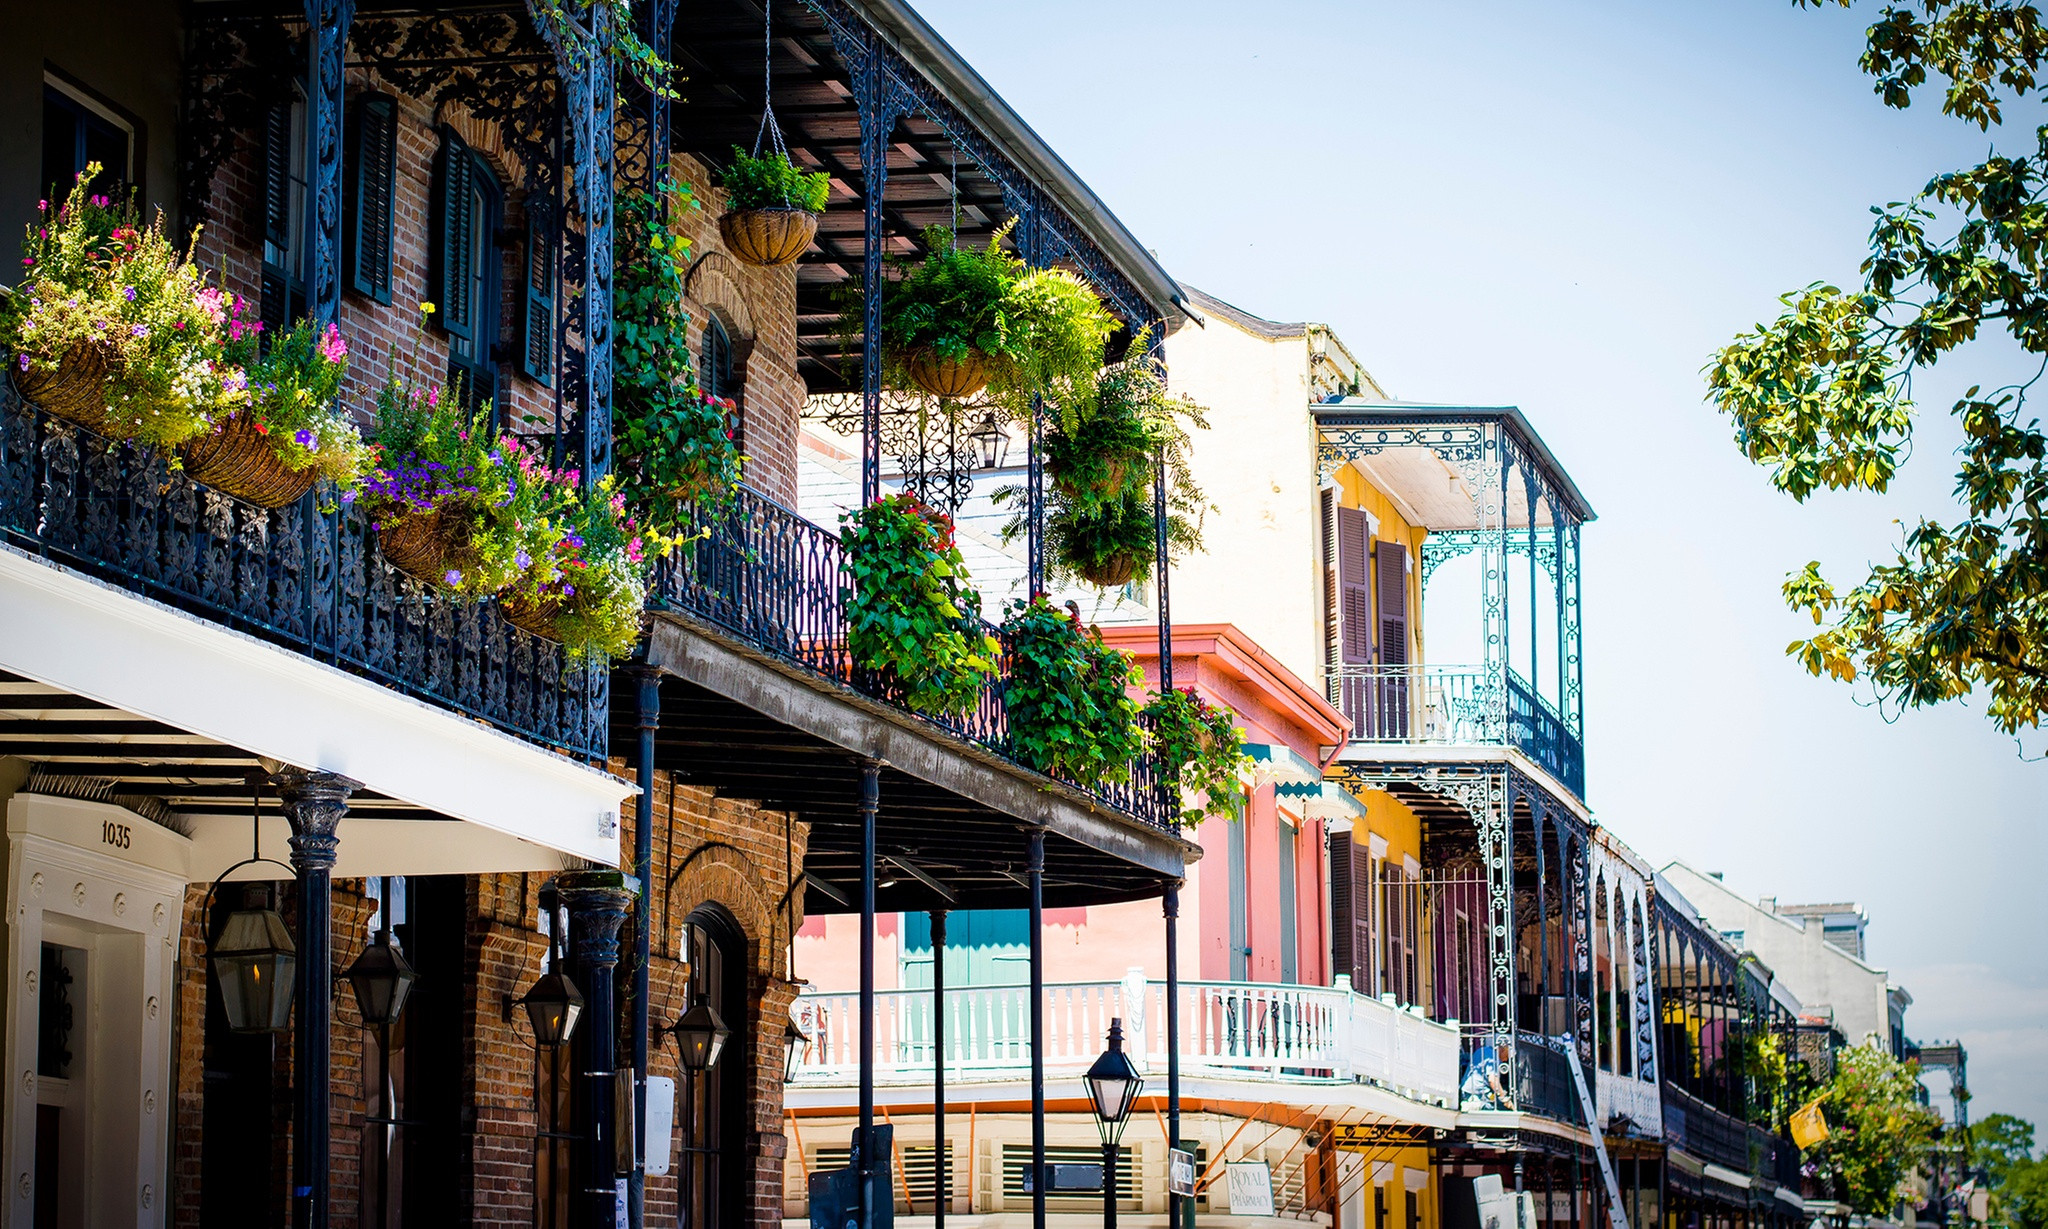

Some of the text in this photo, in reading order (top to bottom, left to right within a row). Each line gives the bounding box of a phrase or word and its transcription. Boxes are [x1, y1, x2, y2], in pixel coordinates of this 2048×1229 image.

[102, 820, 131, 850] 1035
[1230, 1167, 1266, 1196] ROYAL
[1231, 1193, 1269, 1207] PHARMACY
